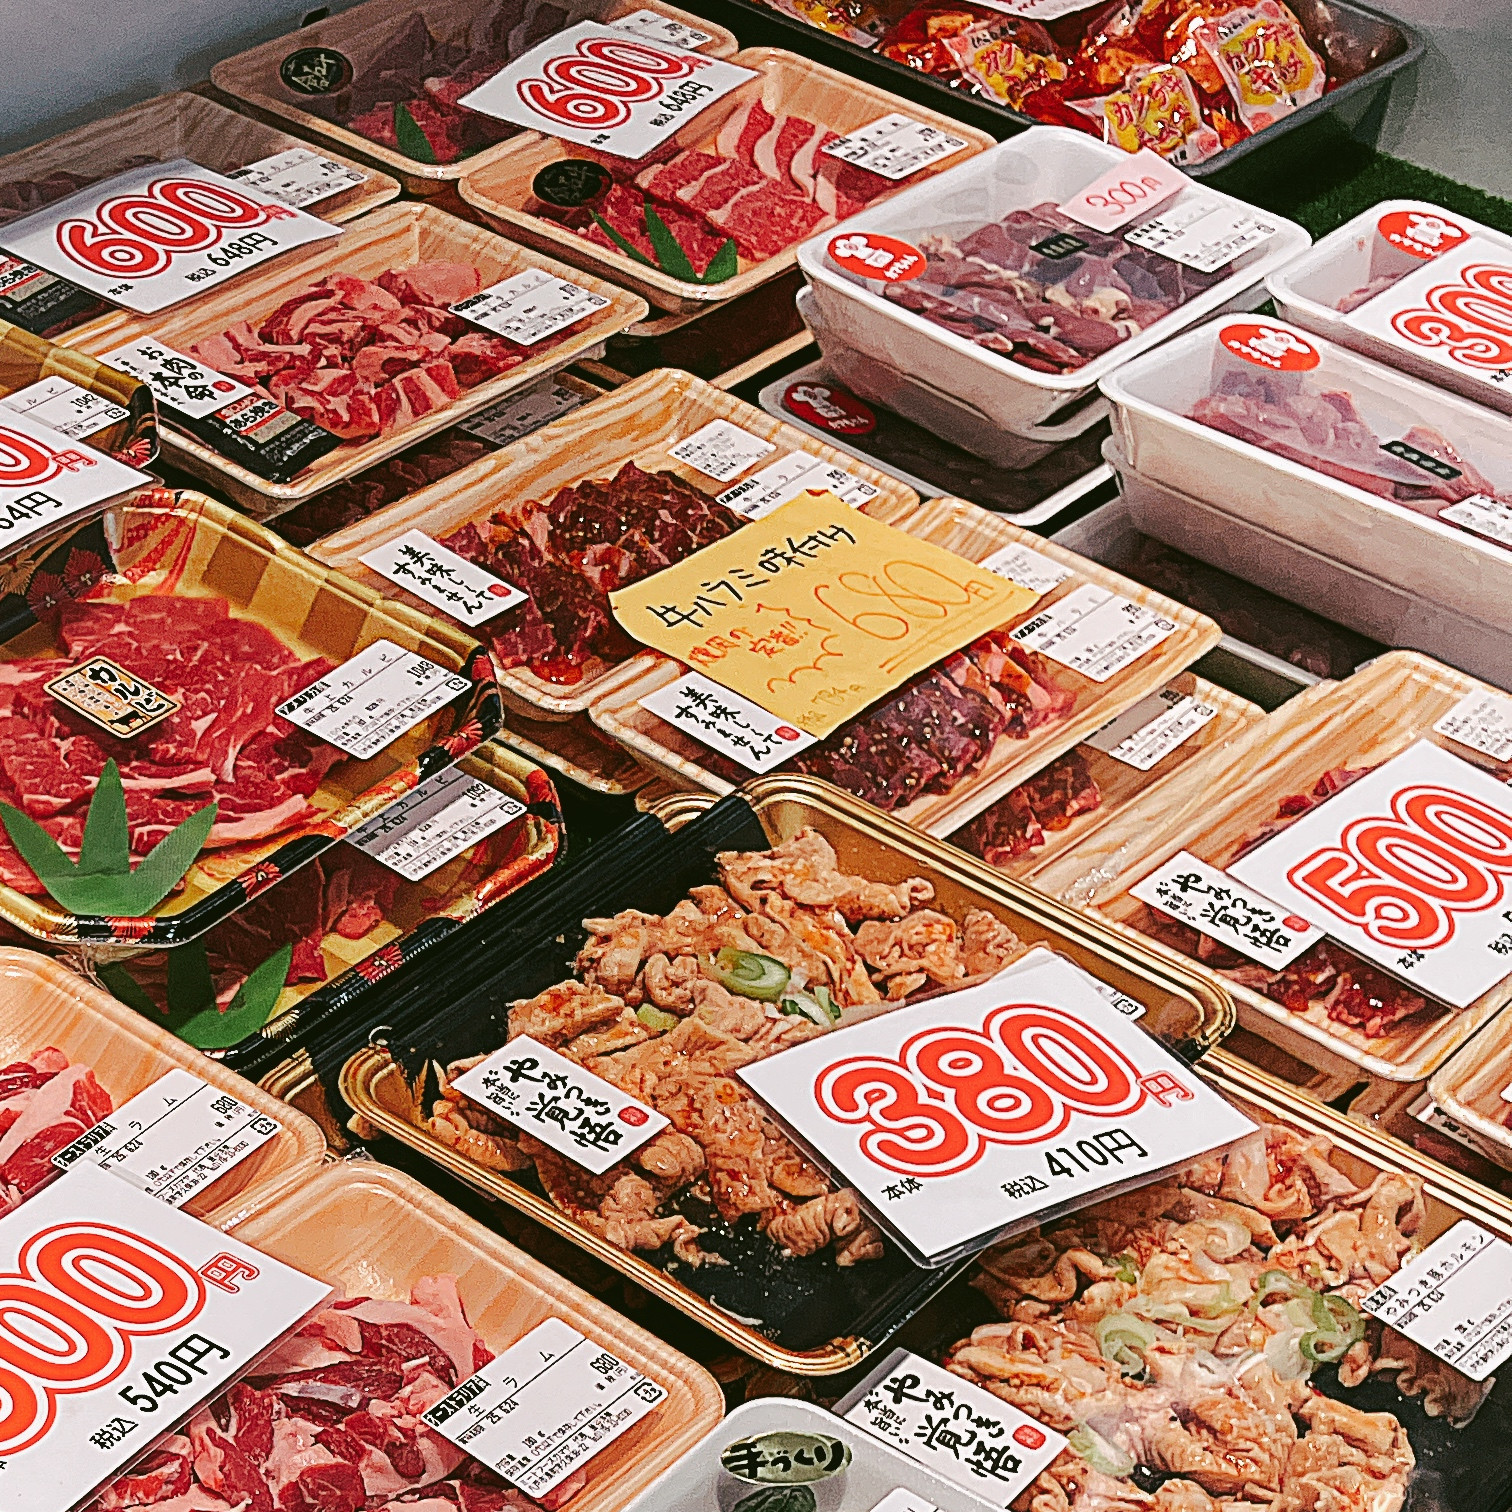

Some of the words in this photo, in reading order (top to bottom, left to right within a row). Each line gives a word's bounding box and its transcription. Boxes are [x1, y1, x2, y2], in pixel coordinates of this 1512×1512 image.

[56, 177, 298, 279] 600円
[207, 232, 278, 268] 648円
[503, 1056, 613, 1115] やみつき
[814, 1003, 1196, 1178] 380円
[881, 1177, 923, 1203] 本体
[1001, 1173, 1049, 1201] 税込
[1044, 1127, 1149, 1180] 410円
[89, 1417, 139, 1451] 税込
[118, 1333, 230, 1413] 540円
[467, 1351, 555, 1418] 生ラム
[883, 1373, 1005, 1438] やみつき
[721, 1440, 845, 1479] 手づくり
[913, 1413, 1023, 1482] 覚悟
